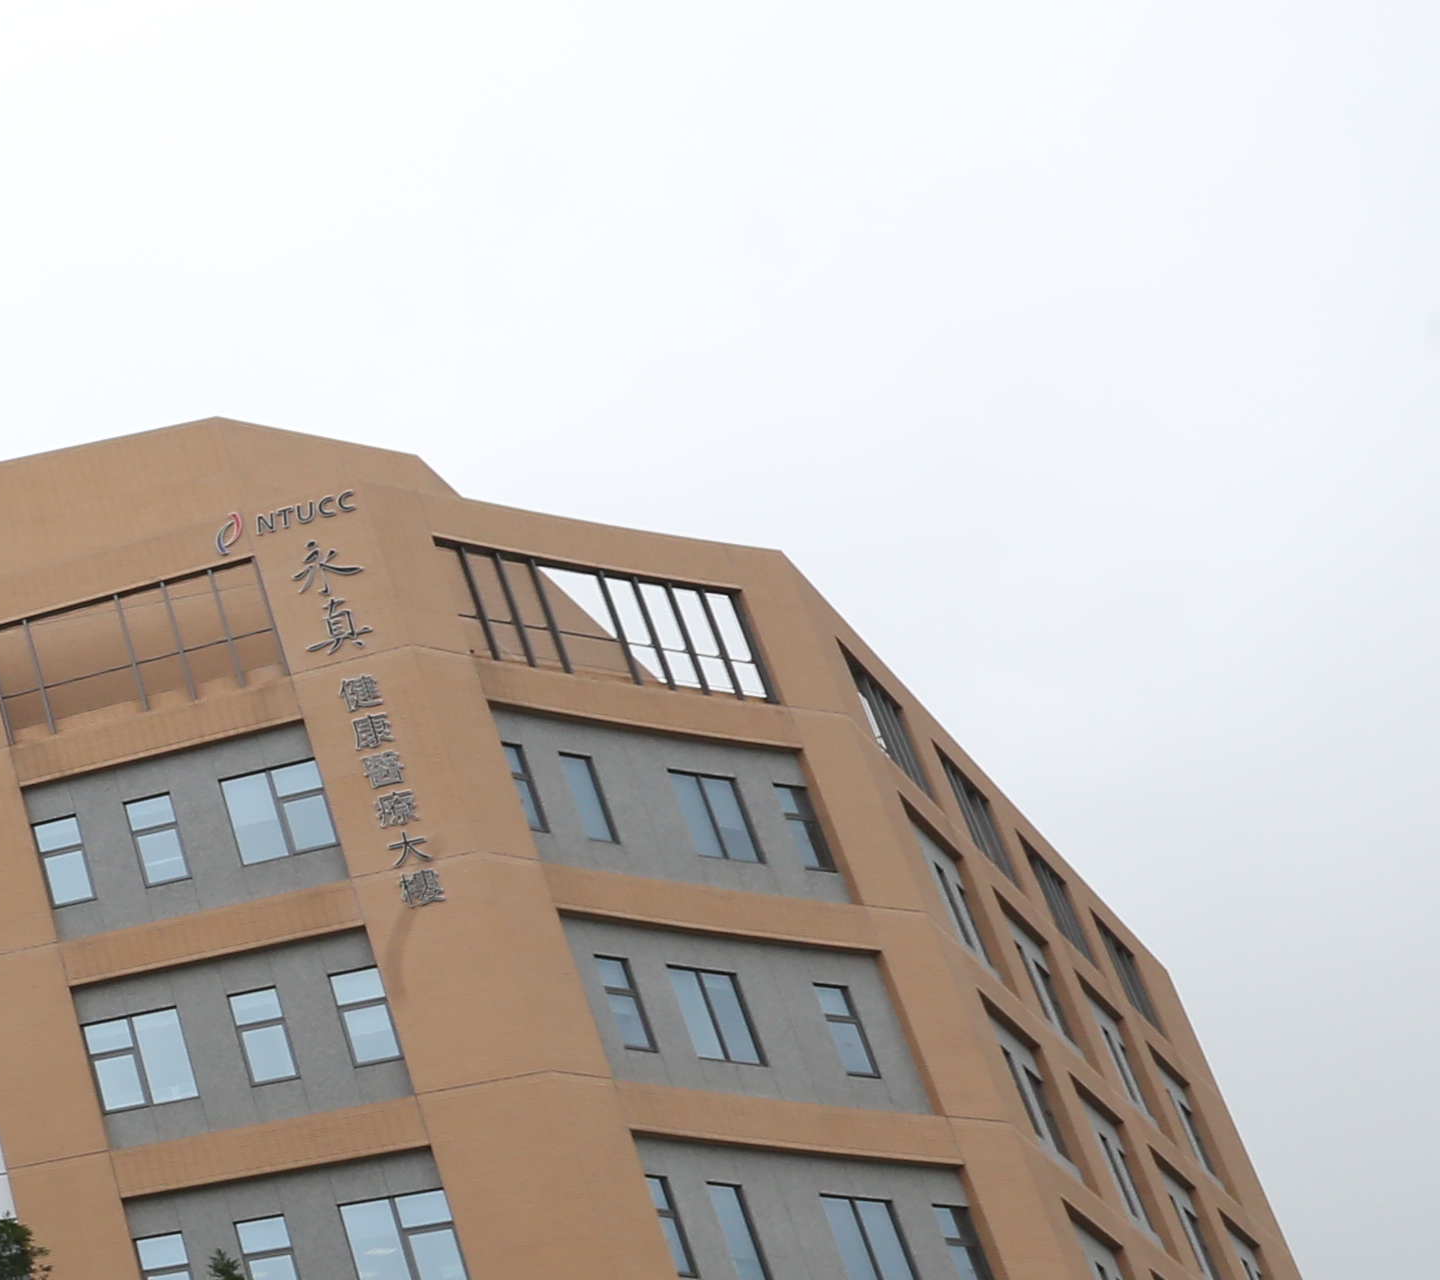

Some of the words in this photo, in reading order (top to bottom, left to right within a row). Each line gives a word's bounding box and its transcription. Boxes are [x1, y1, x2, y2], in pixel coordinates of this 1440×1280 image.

[255, 489, 357, 535] NTUCC
[292, 540, 373, 655] 永真
[338, 673, 446, 908] 健康醫療大樓
